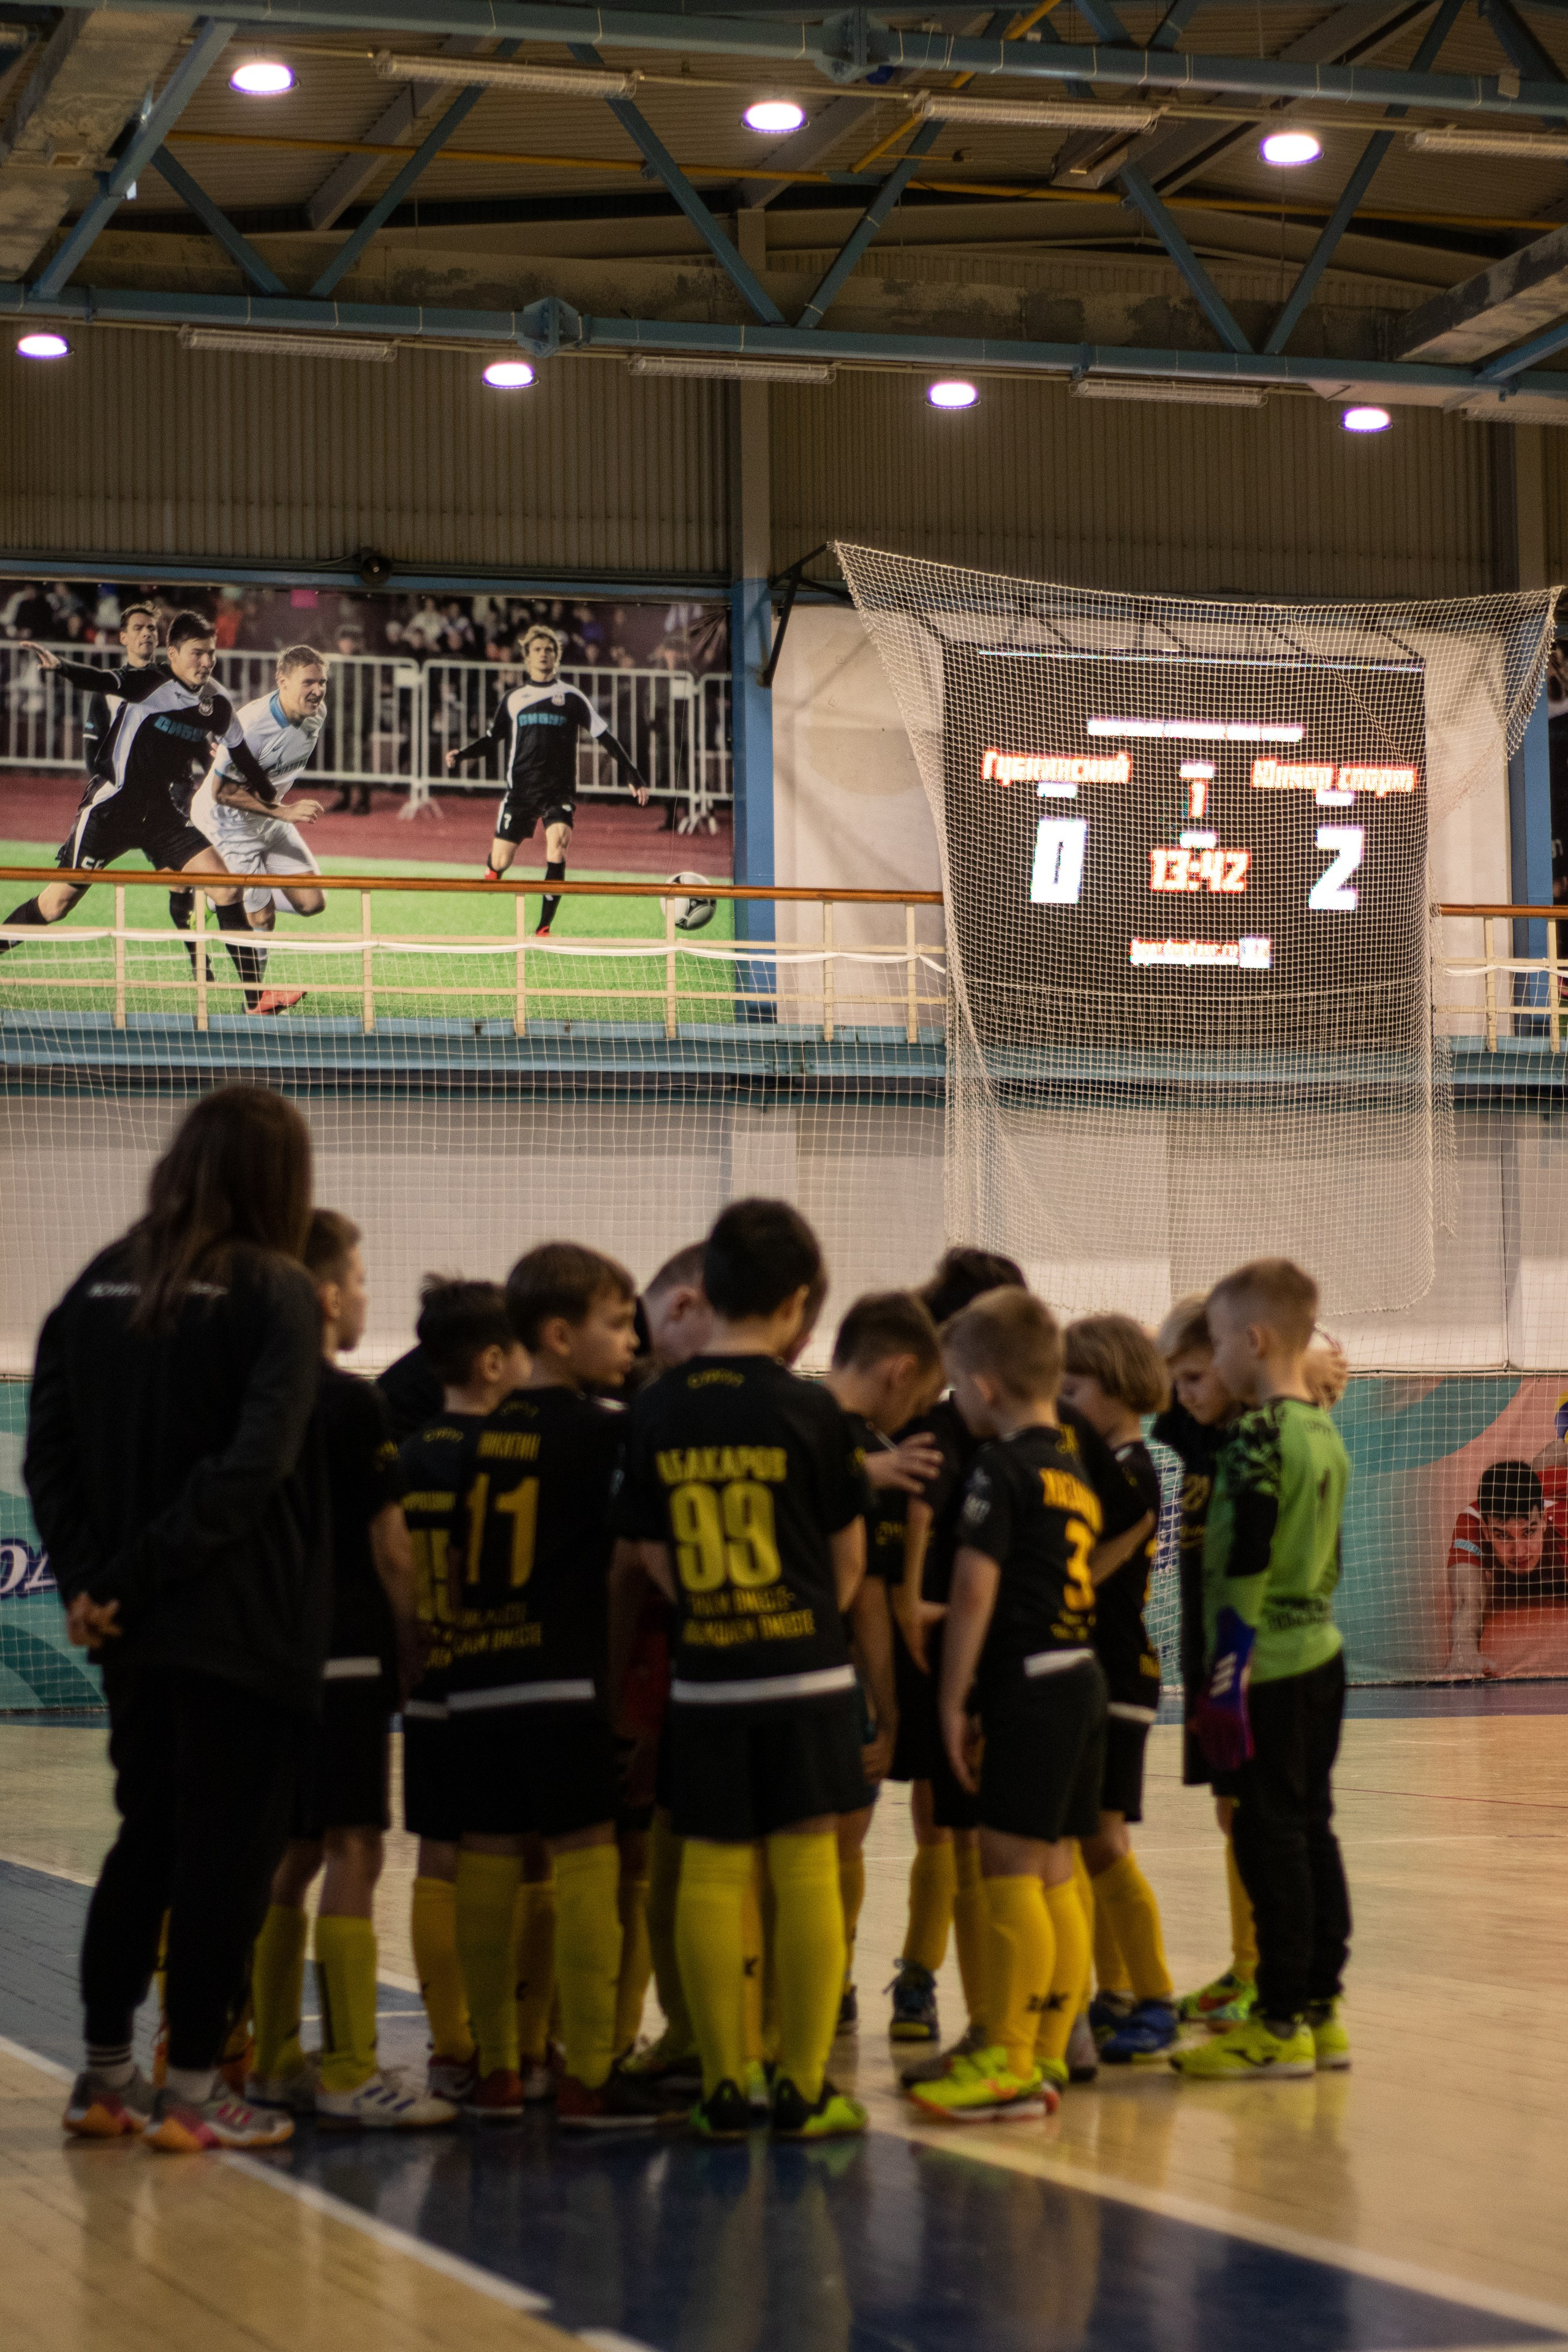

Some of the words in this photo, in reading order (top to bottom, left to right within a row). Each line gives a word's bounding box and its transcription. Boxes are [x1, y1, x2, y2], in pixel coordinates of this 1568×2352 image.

[1189, 782, 1207, 818] 1
[1030, 820, 1087, 904] 0
[1150, 849, 1250, 893] 13:42
[1308, 826, 1363, 910] 2
[466, 1471, 541, 1588] 11
[669, 1480, 782, 1593] 99
[1065, 1518, 1096, 1611] 3
